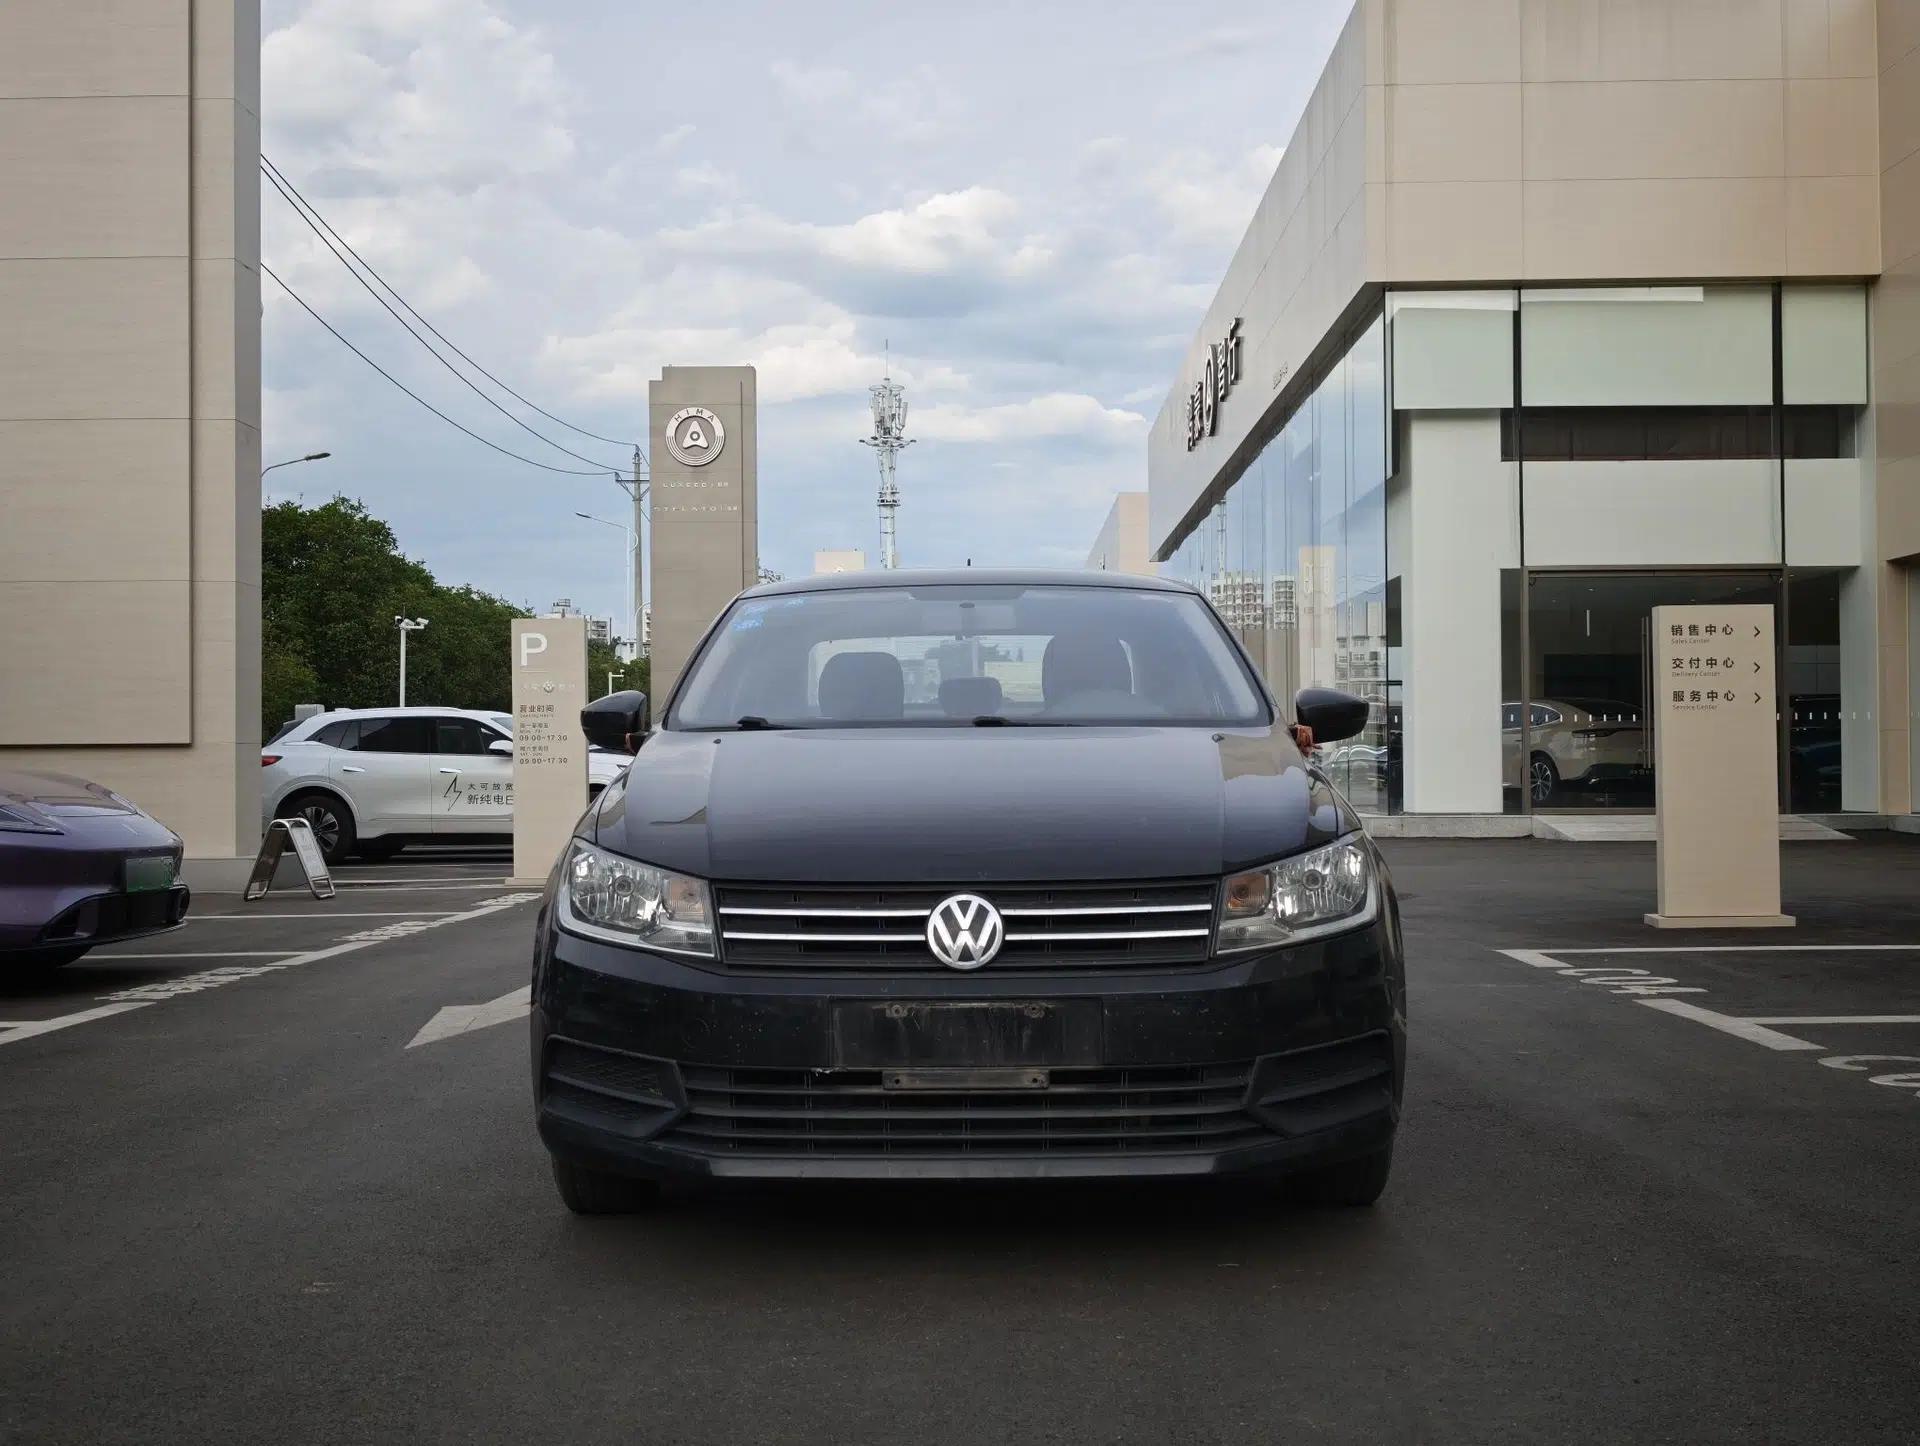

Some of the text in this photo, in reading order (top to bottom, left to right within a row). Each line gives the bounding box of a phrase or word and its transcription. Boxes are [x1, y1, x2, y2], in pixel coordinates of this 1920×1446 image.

[674, 408, 714, 422] HIMA
[1671, 623, 1734, 636] 销售中心
[520, 632, 548, 667] P
[1672, 657, 1734, 669] 交付中心
[1672, 690, 1735, 702] 服务中心
[1556, 967, 1710, 995] C04
